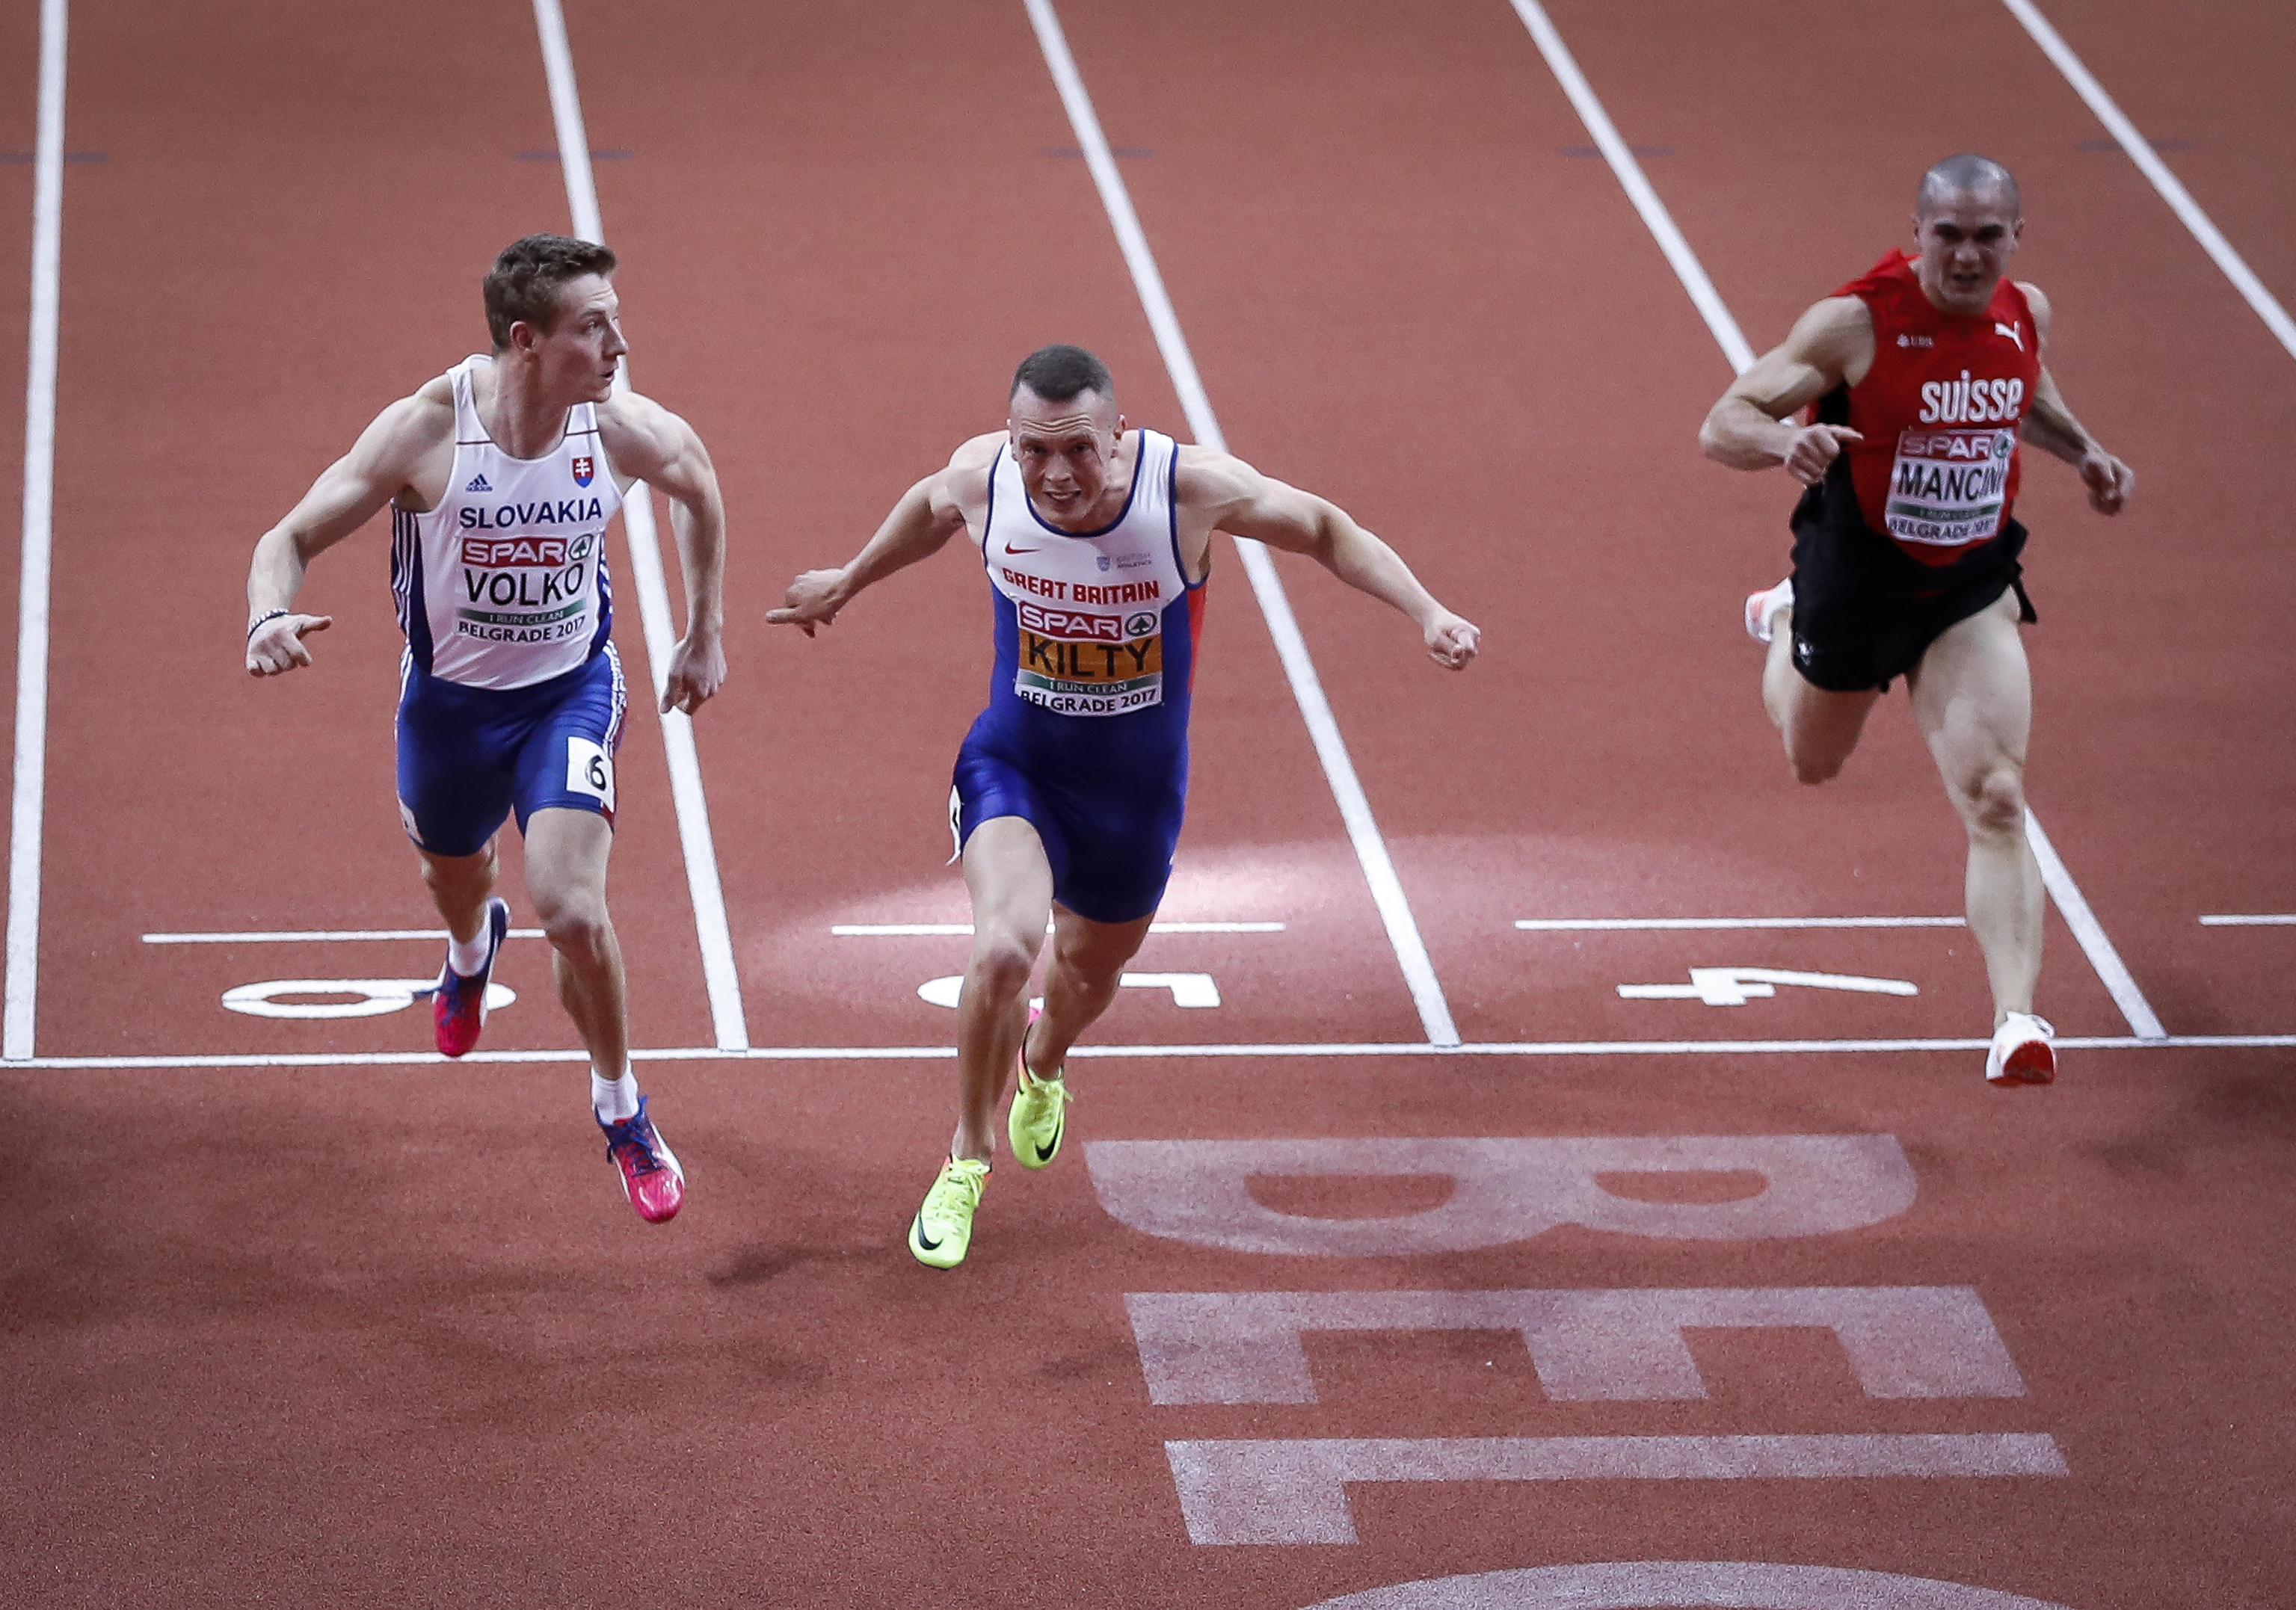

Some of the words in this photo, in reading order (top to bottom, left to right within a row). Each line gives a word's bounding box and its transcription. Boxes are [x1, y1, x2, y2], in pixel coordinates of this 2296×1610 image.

[1919, 369, 2025, 424] suisse
[1900, 434, 1991, 459] SPAR
[459, 498, 602, 528] SLOVAKIA
[464, 540, 565, 564] SPAR
[464, 564, 584, 606] VOLKO
[1002, 568, 1067, 599] GREAT
[1073, 581, 1160, 605] BRITAIN
[458, 621, 552, 643] BELGRADE
[554, 615, 585, 637] 2017
[1021, 605, 1119, 638] SPAR
[1027, 633, 1153, 676] KILTY
[1021, 690, 1115, 712] BELGRADE
[1121, 688, 1157, 708] 2017
[1050, 681, 1055, 691] I
[1056, 683, 1083, 692] RUN
[1087, 683, 1127, 693] CLEAN
[585, 755, 606, 791] 6
[221, 978, 517, 1019] 6
[1616, 966, 1919, 1006] 4
